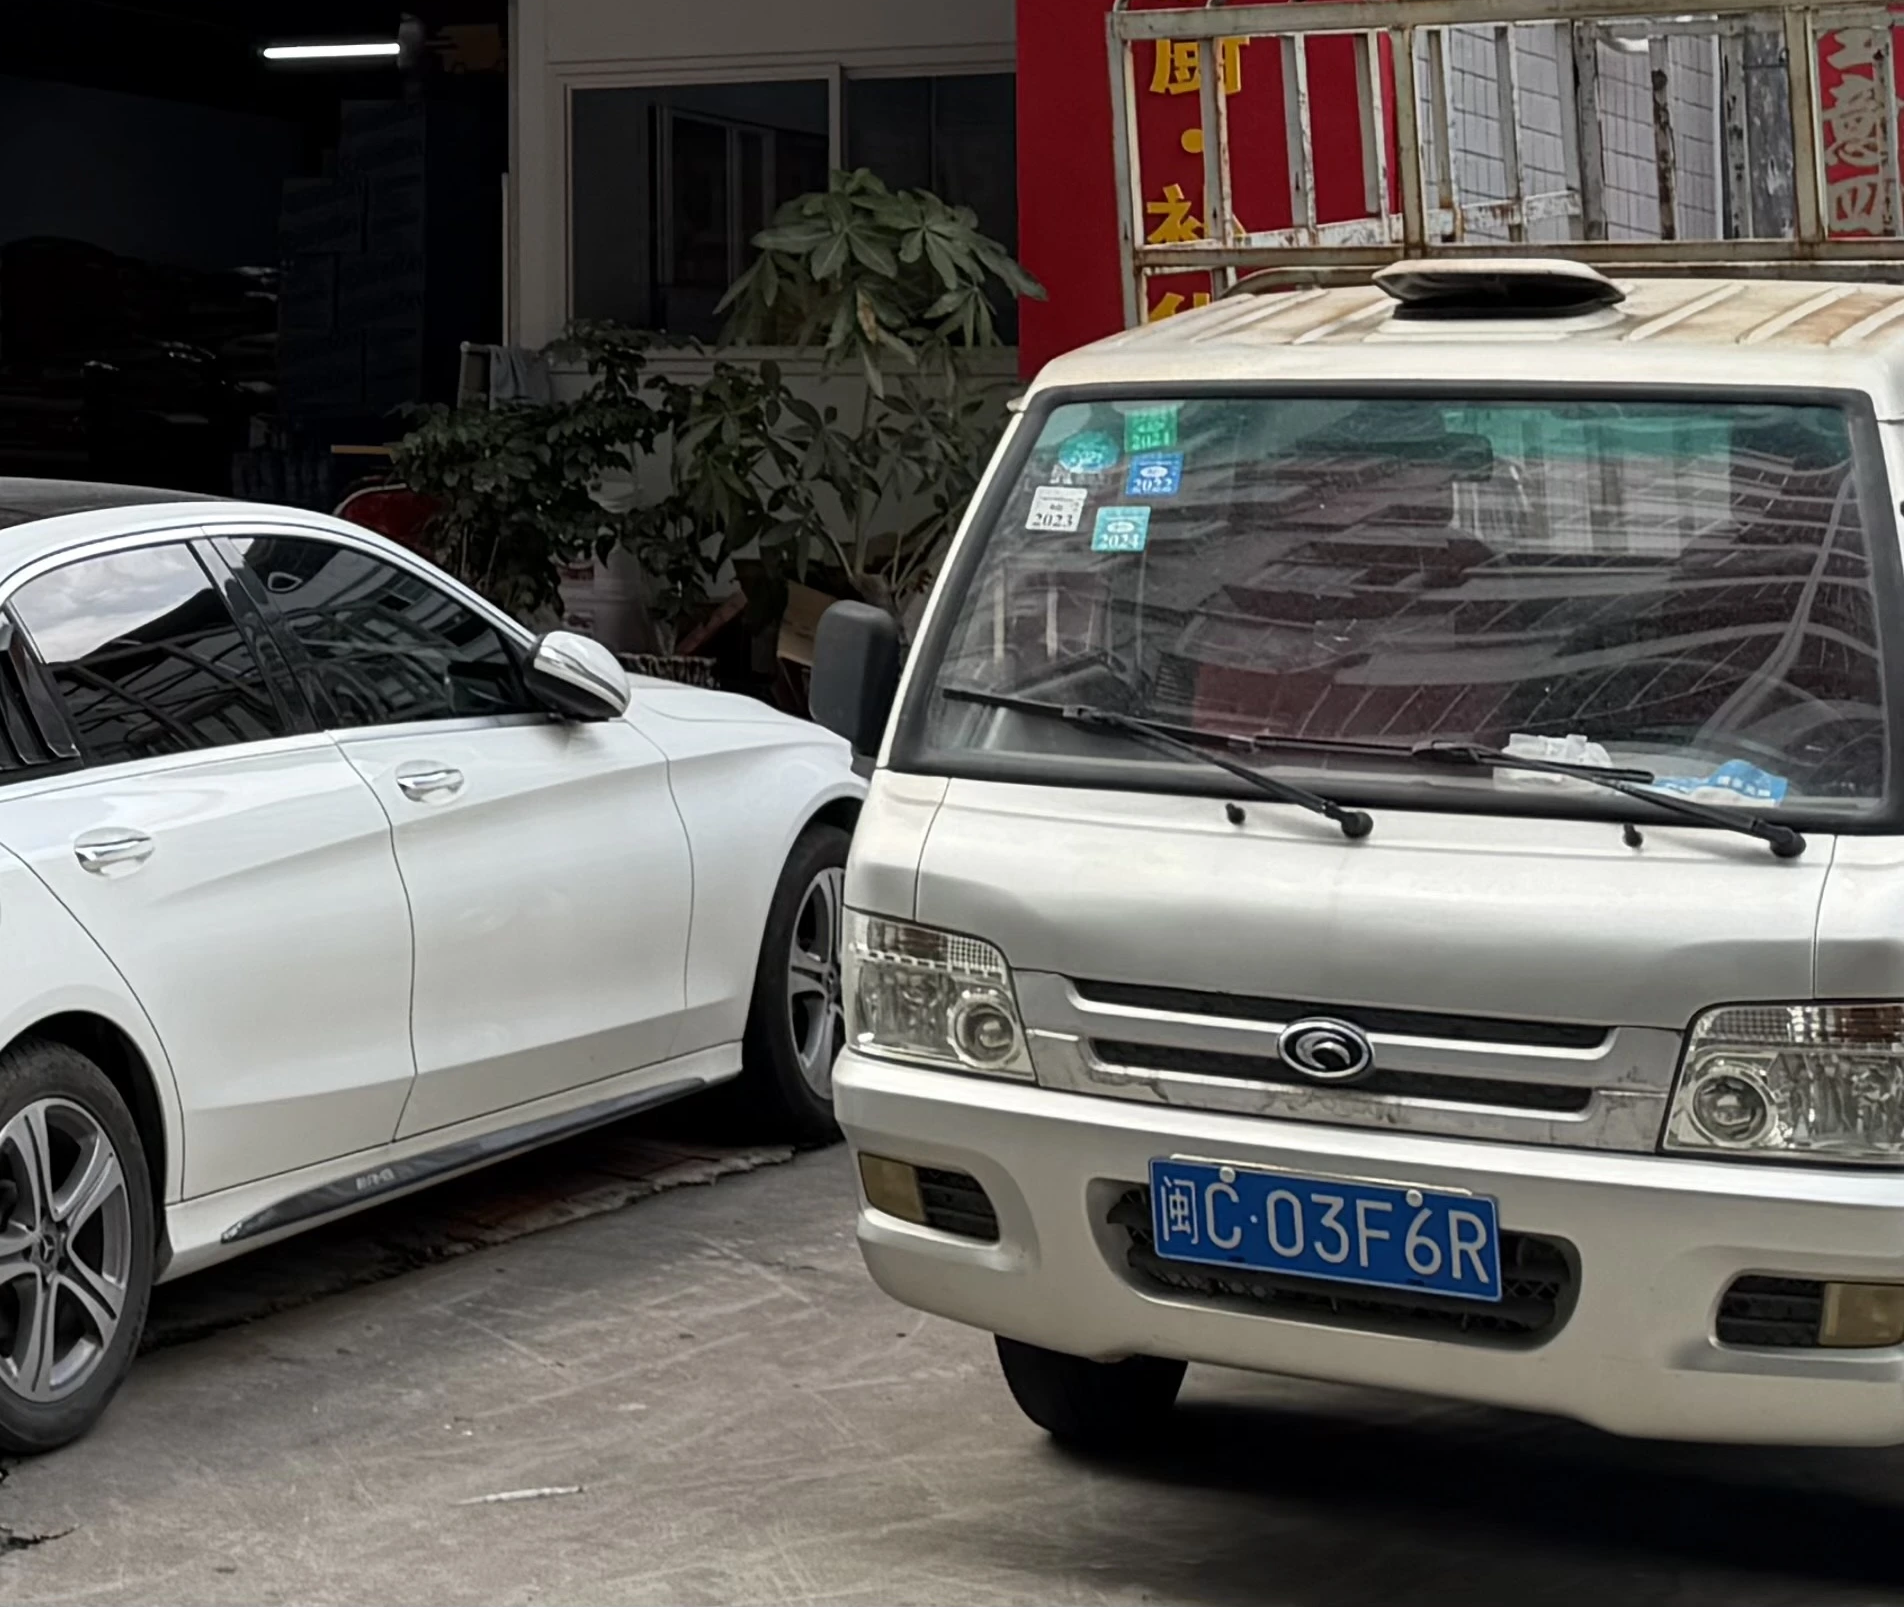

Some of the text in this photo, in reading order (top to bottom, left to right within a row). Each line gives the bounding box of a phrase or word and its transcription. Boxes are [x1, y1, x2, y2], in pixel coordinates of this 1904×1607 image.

[1131, 478, 1173, 494] 2022
[1031, 513, 1073, 528] 2023
[1099, 533, 1140, 550] 2024
[1159, 1175, 1490, 1284] 闽C·03F6R
